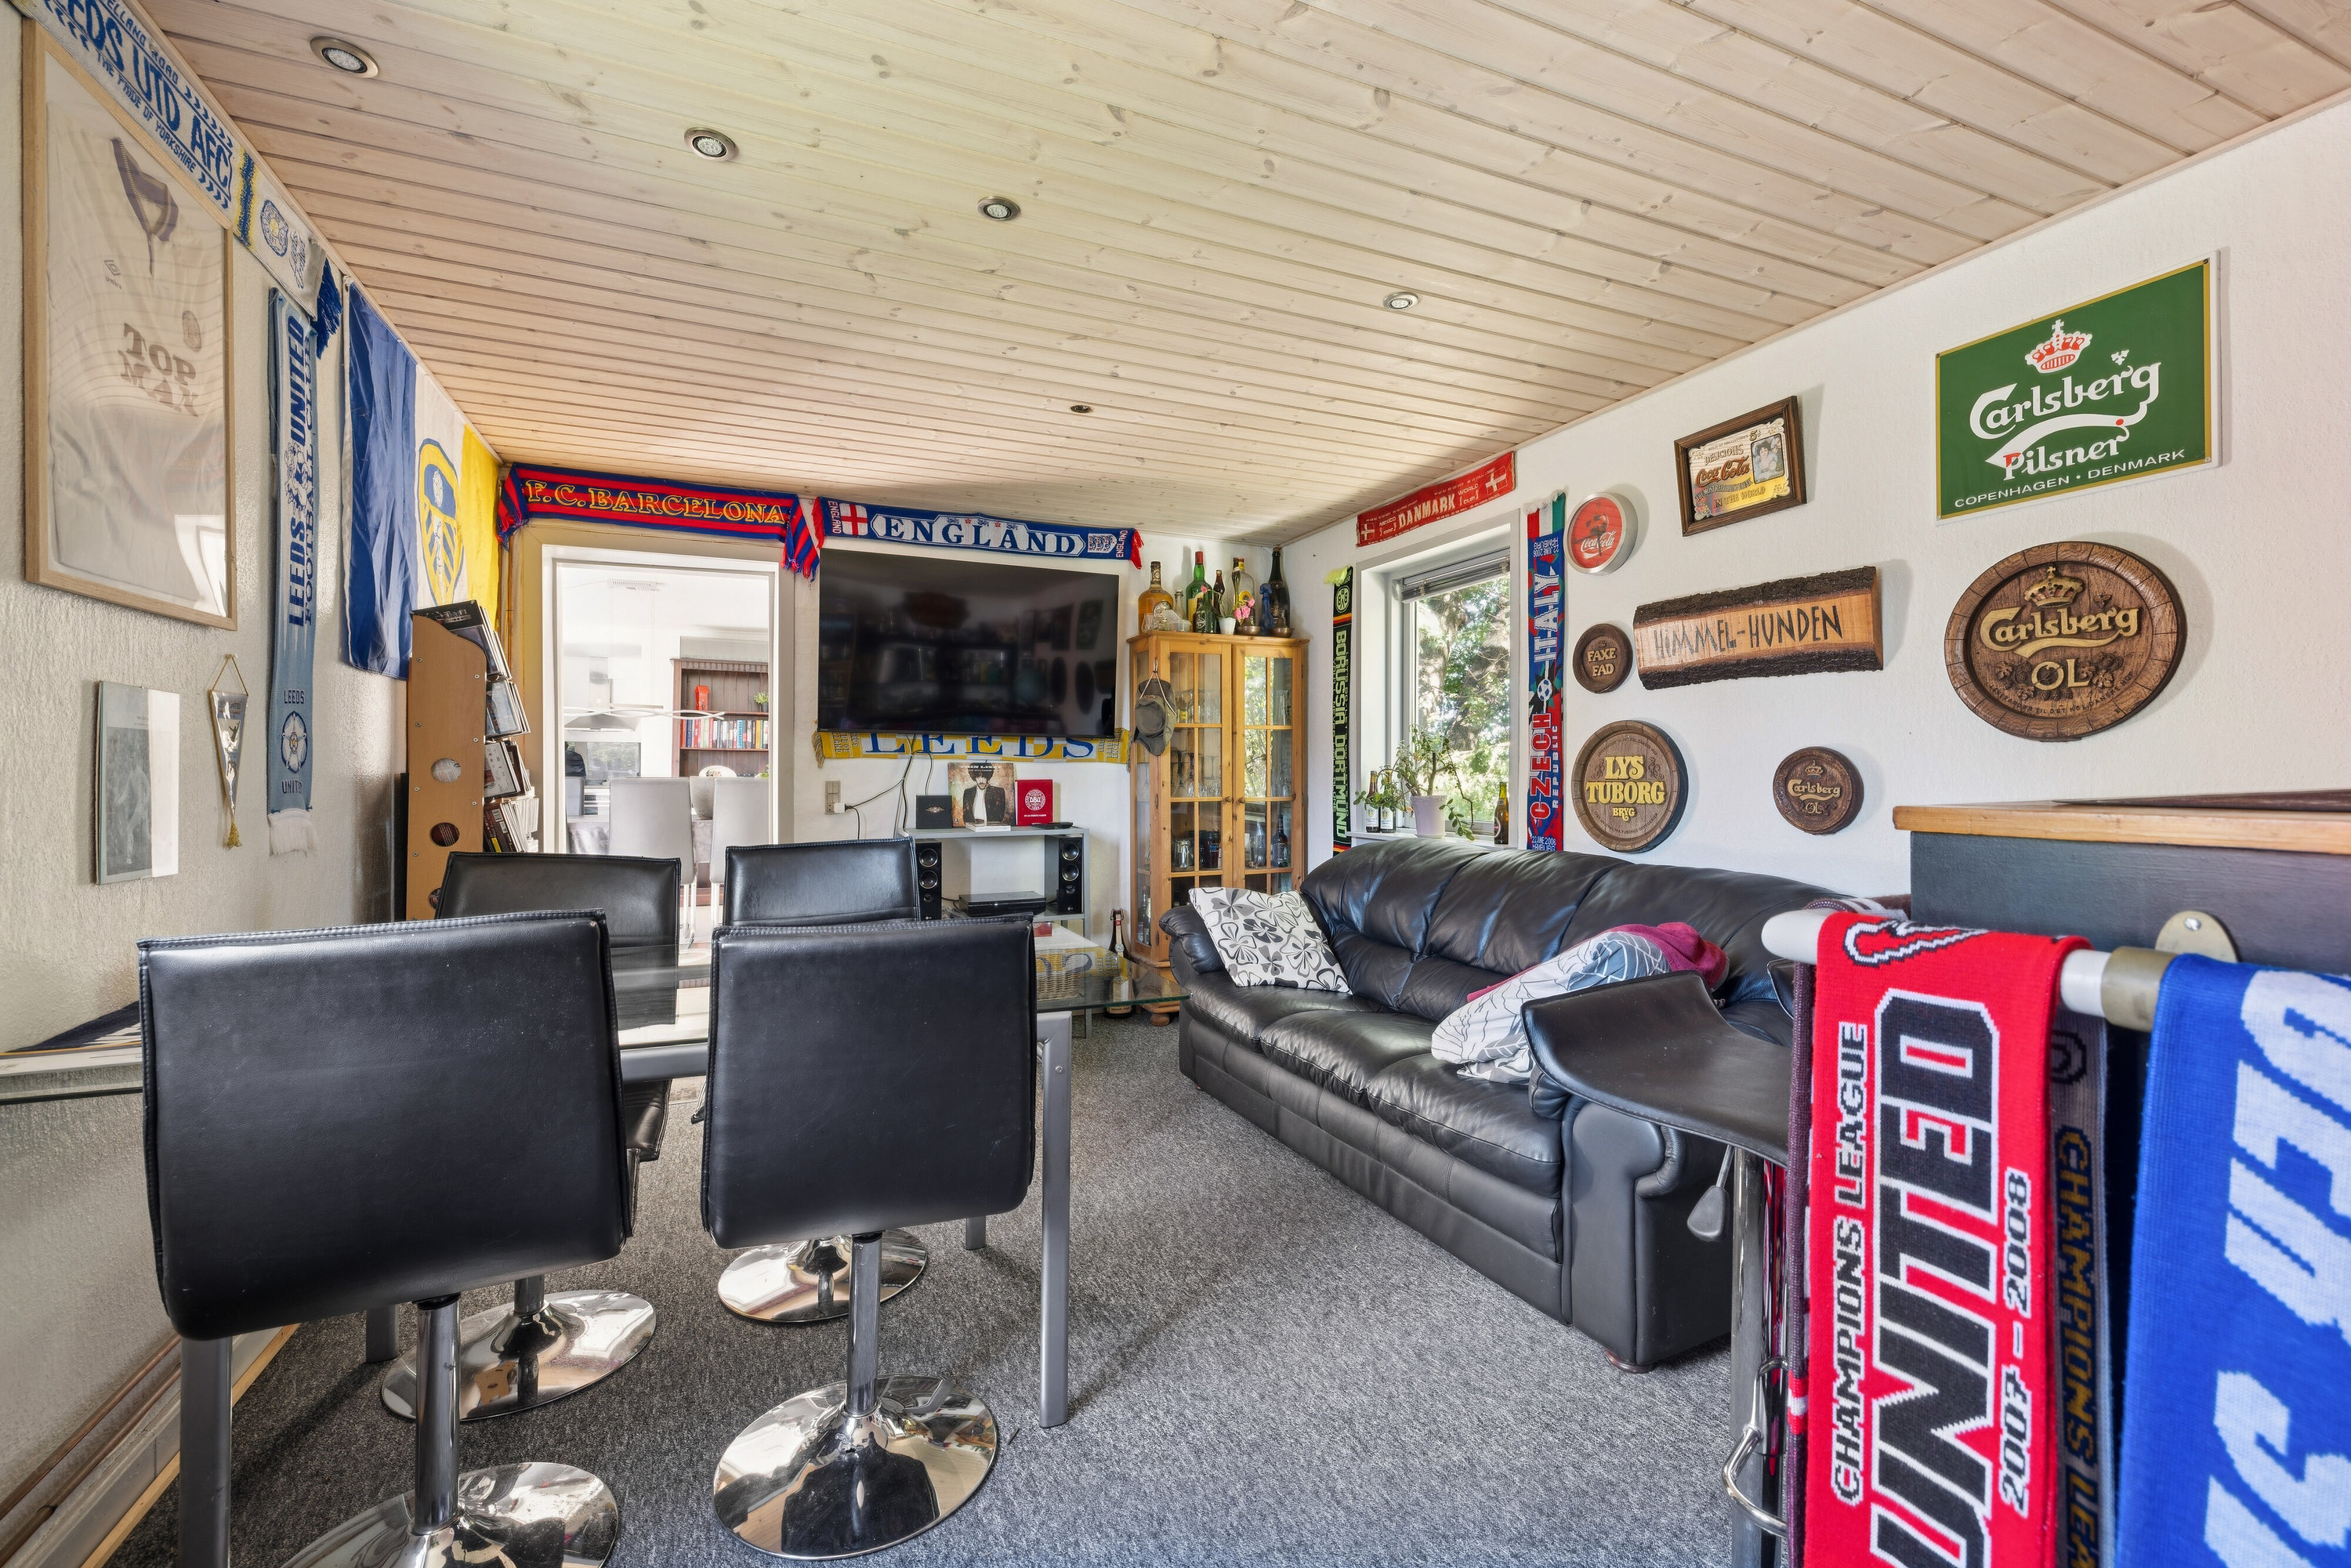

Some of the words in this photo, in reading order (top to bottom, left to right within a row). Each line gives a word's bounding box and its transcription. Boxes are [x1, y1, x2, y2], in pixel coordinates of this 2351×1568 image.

[96, 49, 114, 78] THE
[143, 107, 154, 122] OF
[155, 121, 197, 173] YORKSHIRE
[132, 43, 180, 132] UTD
[190, 114, 229, 188] AFC
[123, 322, 197, 386] TOP
[118, 349, 199, 418] MAN
[288, 315, 306, 447] UNITED
[1969, 359, 2162, 440] Carlsberg
[1704, 443, 1744, 466] DELICIOUS
[2001, 426, 2130, 482] Pilsner
[1457, 483, 1479, 496] WORLD
[1695, 492, 1704, 502] THE
[1713, 498, 1722, 508] IN
[1724, 494, 1740, 505] THE
[1741, 486, 1766, 500] WORLD
[1954, 475, 2070, 509] COPENHAGEN
[2087, 448, 2186, 480] DENMARK
[589, 487, 786, 525] BARCELONA
[827, 500, 842, 534] ENGLAND
[1378, 516, 1396, 527] MEXICO
[1398, 493, 1456, 529] DANMARK
[305, 444, 314, 626] FOOTBALL
[884, 516, 1077, 555] ENGLAND
[1115, 530, 1128, 558] ENGLAND
[1534, 536, 1559, 550] HAMBURG
[288, 516, 306, 627] LEEDS
[1534, 573, 1560, 663] ITALY
[1980, 605, 2141, 652] Carlsberg
[1335, 629, 1347, 725] BORUSSIA
[1587, 647, 1617, 662] FAXE
[1592, 663, 1614, 677] FAD
[284, 690, 305, 704] LEEDS
[2089, 686, 2121, 708] DANSKE
[2120, 671, 2134, 686] HOF
[1335, 734, 1347, 838] DORTMUND
[1530, 712, 1552, 820] CZECH
[1604, 755, 1645, 780] LYS
[1788, 779, 1841, 798] Carlsberg
[1585, 780, 1666, 805] TUBORG
[1612, 806, 1636, 822] BRYG
[1537, 835, 1545, 845] JUNE
[1545, 836, 1557, 846] 2006
[1835, 1020, 1868, 1211] LEAGUE
[2004, 1168, 2032, 1320] 2008
[1871, 988, 2000, 1568] UNITED
[2055, 1124, 2099, 1467] CHAMPIONS
[1830, 1219, 1865, 1507] CHAMPIONS
[1998, 1362, 2033, 1519] 2007
